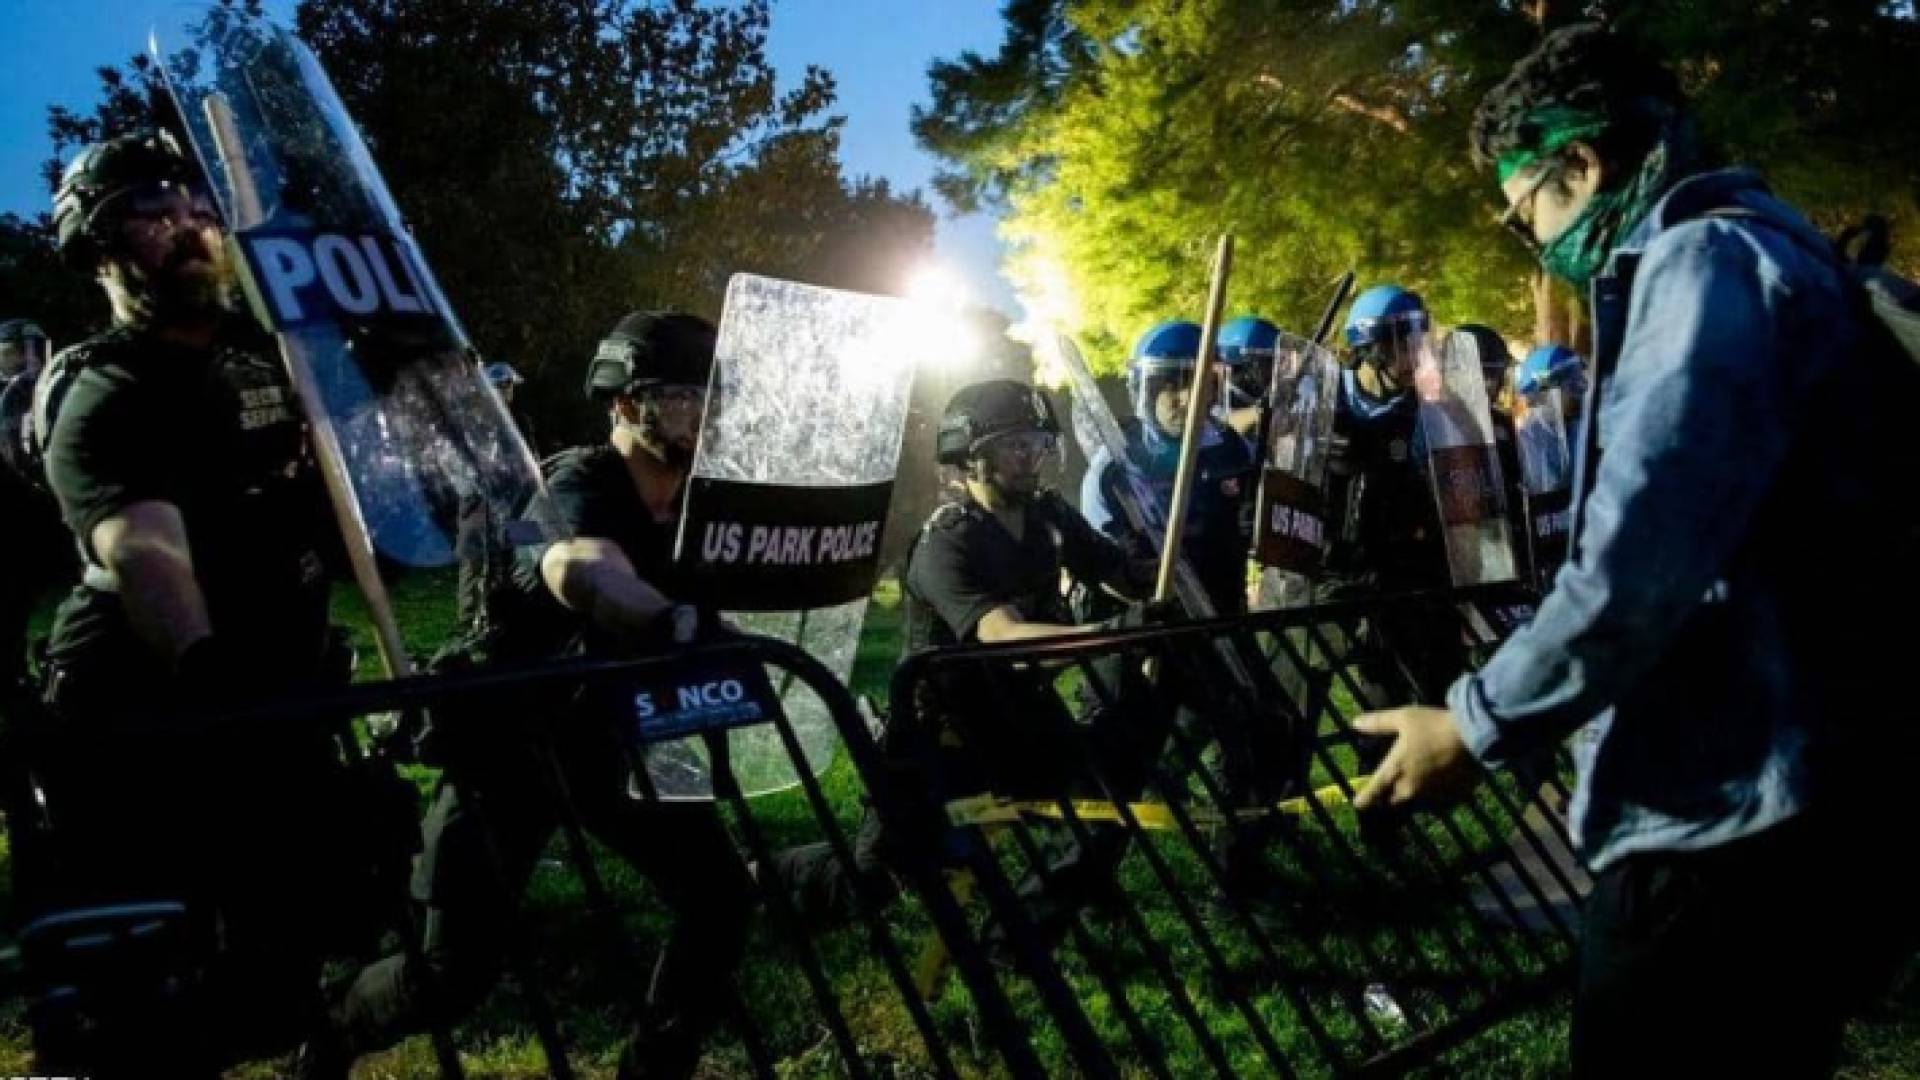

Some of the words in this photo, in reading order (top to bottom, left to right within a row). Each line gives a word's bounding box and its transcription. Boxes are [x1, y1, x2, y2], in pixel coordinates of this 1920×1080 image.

[702, 521, 743, 563] US
[748, 526, 816, 565] PARK
[818, 520, 879, 564] POLICE
